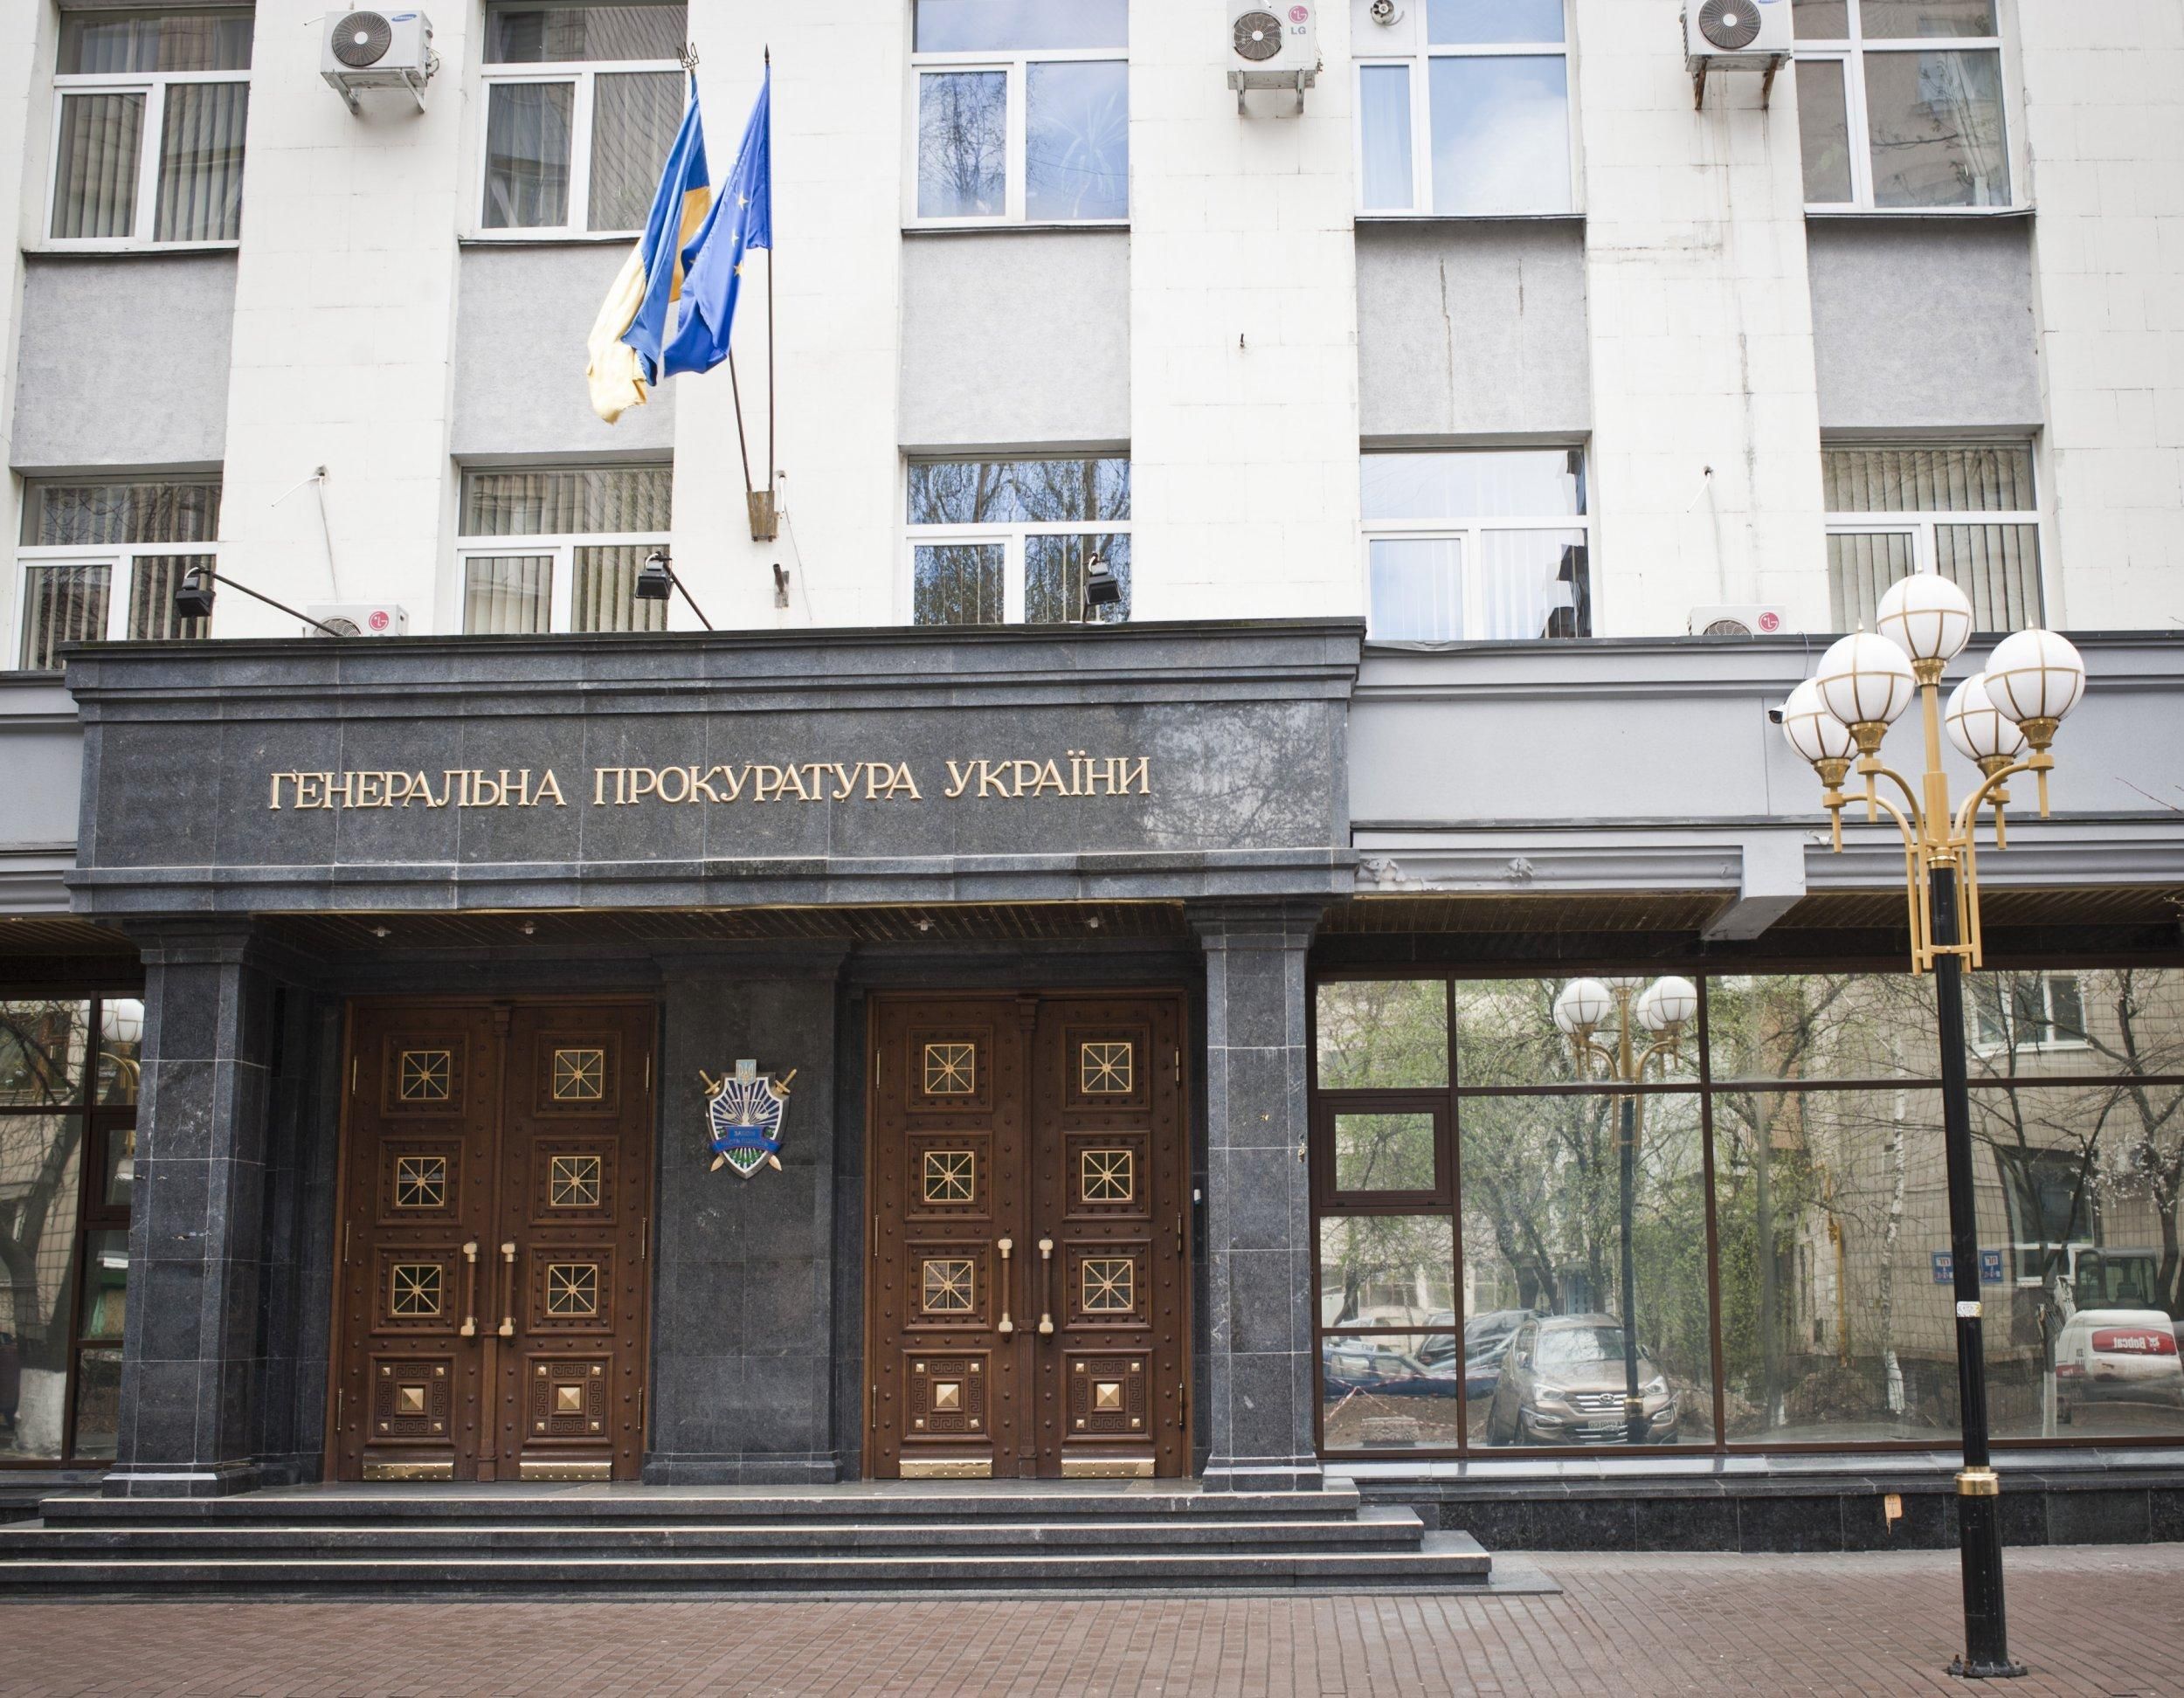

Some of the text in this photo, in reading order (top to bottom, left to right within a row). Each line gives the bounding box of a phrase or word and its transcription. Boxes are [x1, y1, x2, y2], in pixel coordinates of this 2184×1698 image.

[1290, 26, 1307, 35] LG
[269, 749, 1151, 810] ГЕНЕРАЛЬНА ПРОКУРАТУРА УКРАЇНИ
